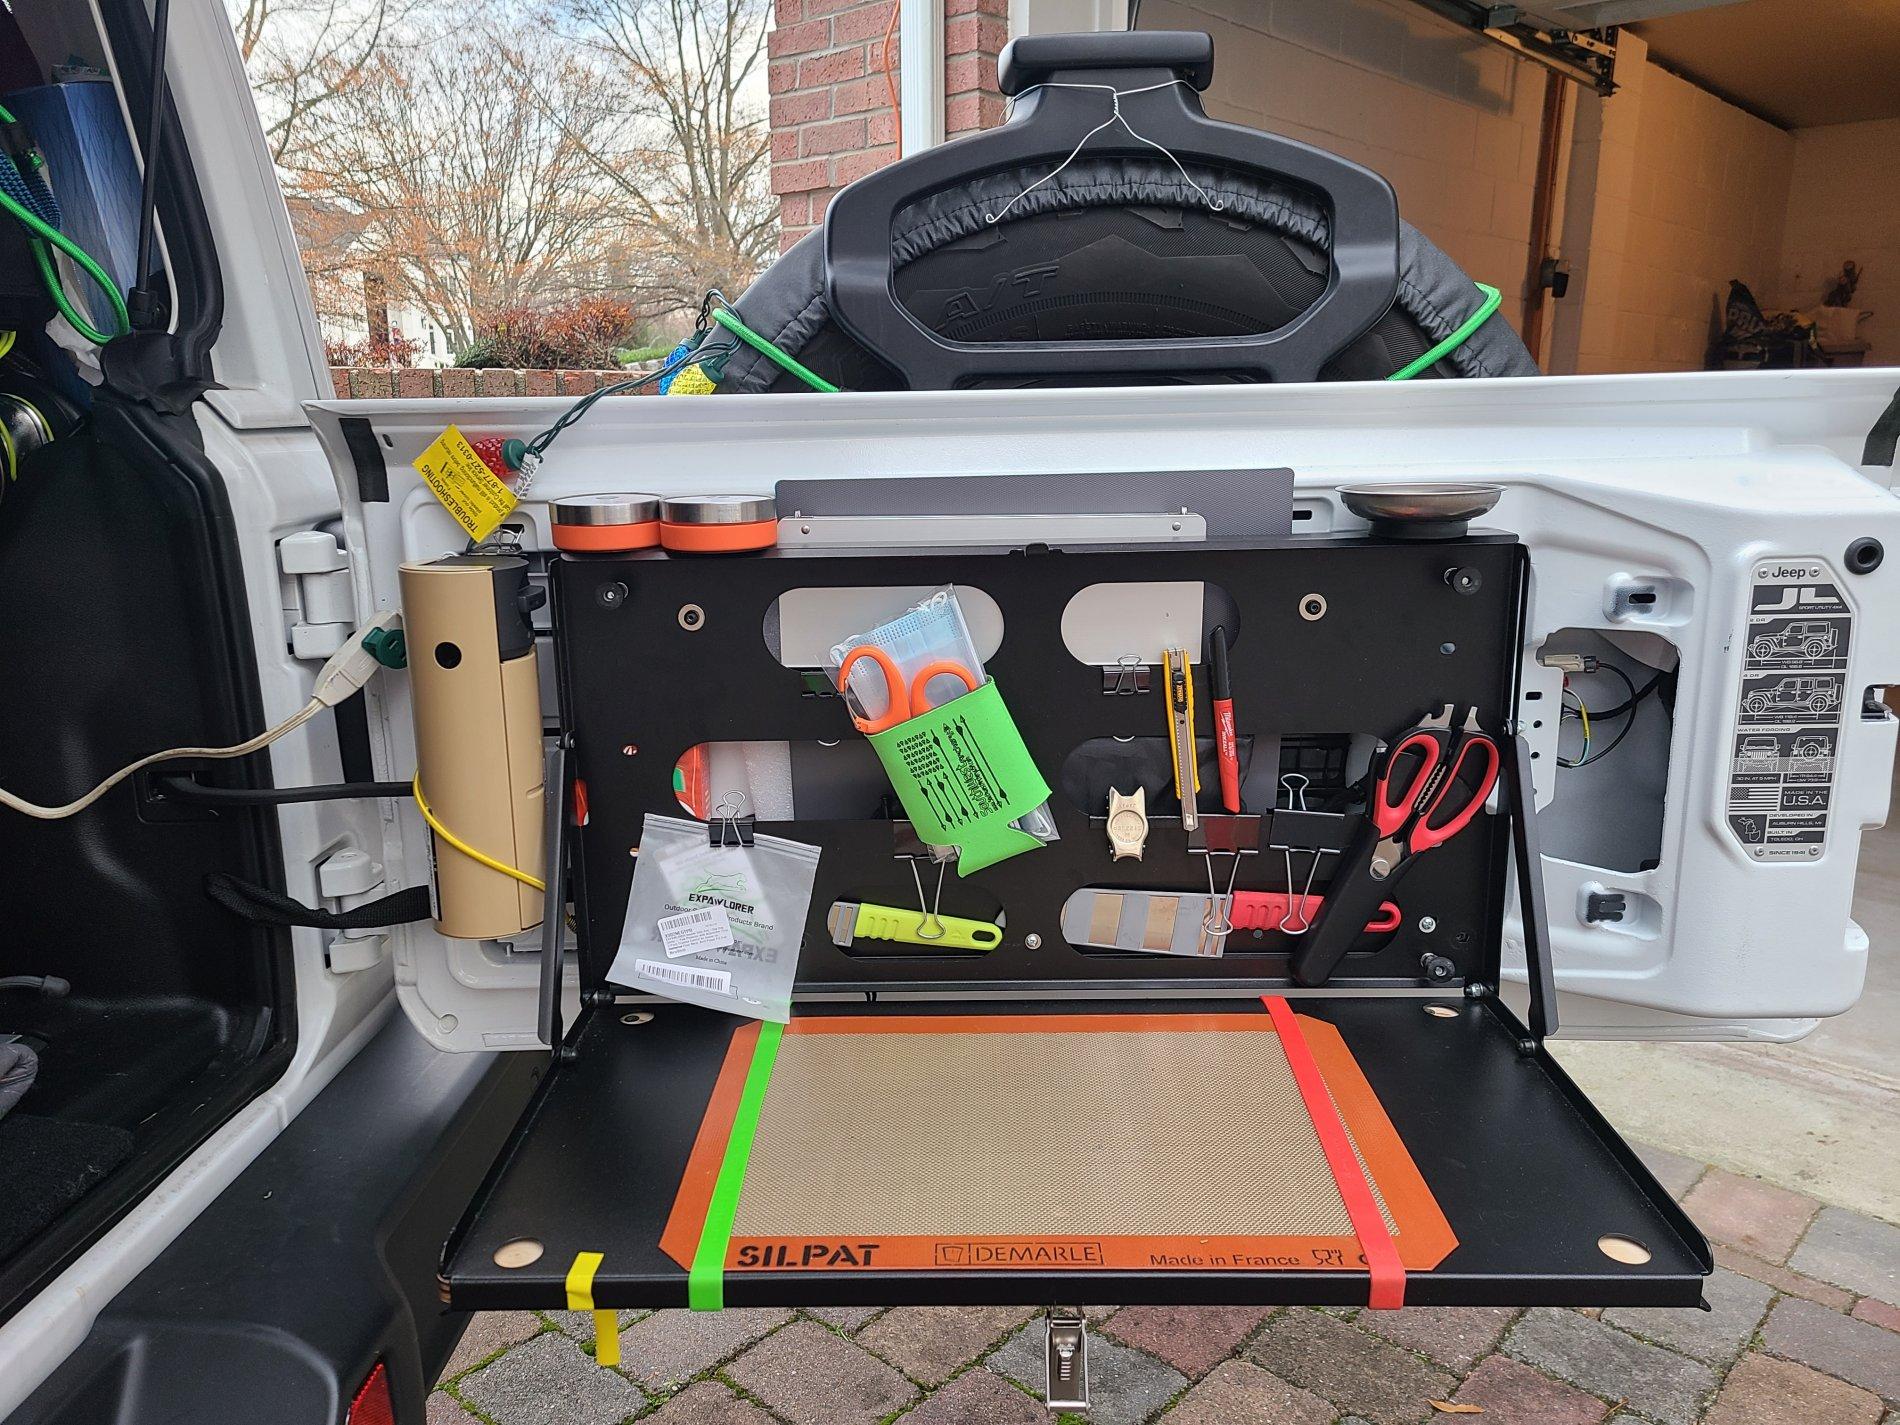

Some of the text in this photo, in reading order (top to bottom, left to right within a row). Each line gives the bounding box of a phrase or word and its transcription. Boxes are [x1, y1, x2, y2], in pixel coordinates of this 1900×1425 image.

[456, 440, 502, 493] 1-877-527-0313
[420, 464, 478, 532] TROUBLESHOOTING
[1772, 567, 1806, 579] Jeep
[1753, 587, 1839, 610] JL
[1783, 796, 1826, 805] U.S.A.
[688, 893, 755, 915] EXPAWLORER
[727, 914, 752, 926] roducts
[753, 919, 774, 931] Brand
[737, 1244, 880, 1267] SILPAT
[976, 1246, 1096, 1262] DEMARLE
[1150, 1254, 1301, 1266] Made in France
